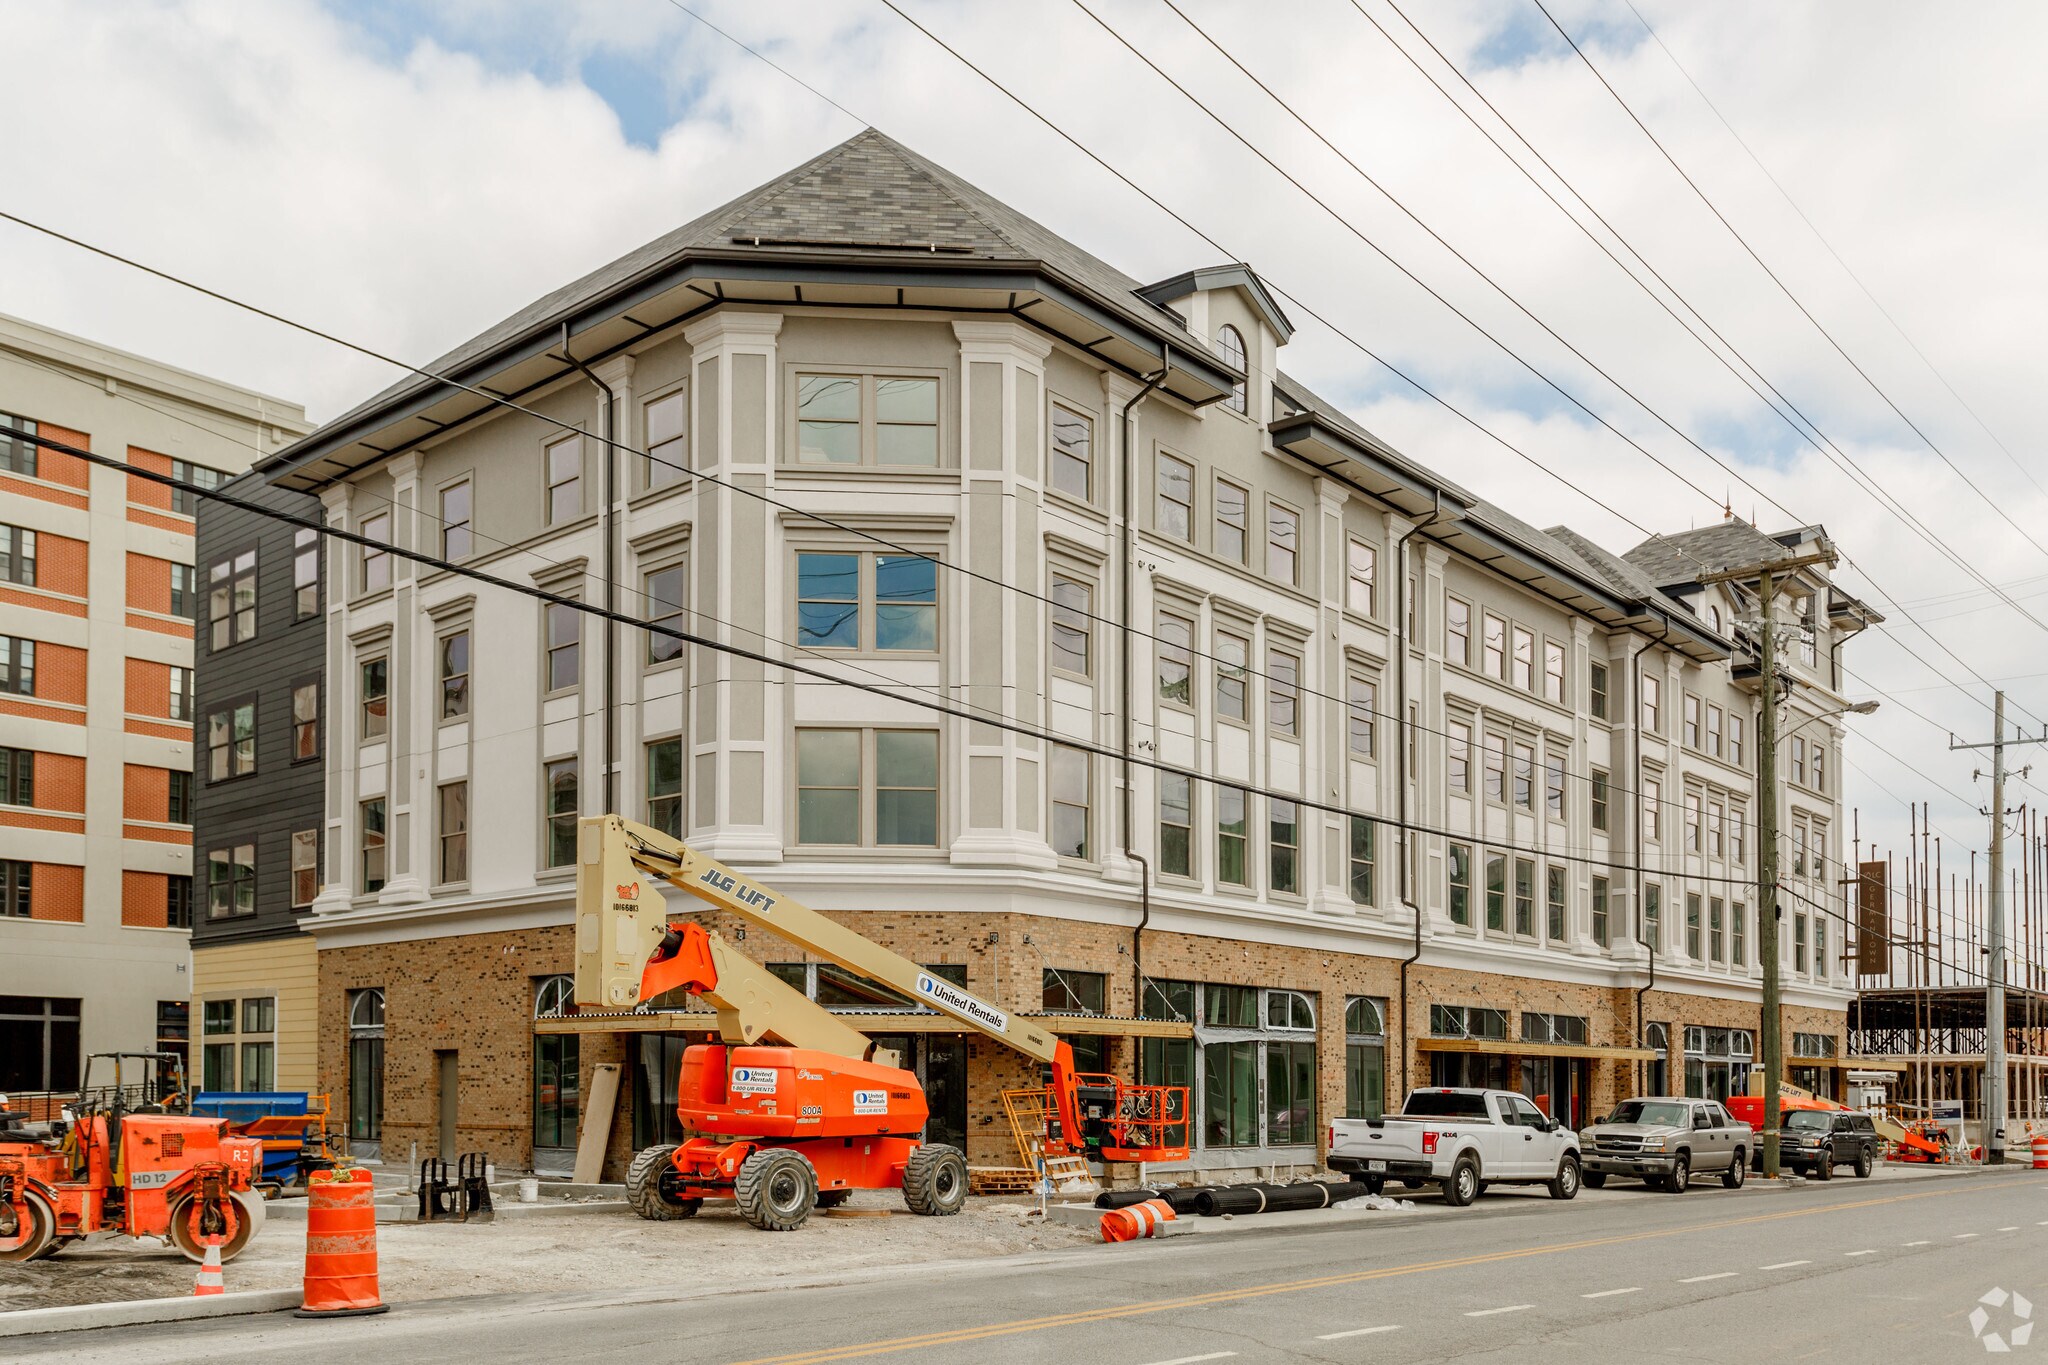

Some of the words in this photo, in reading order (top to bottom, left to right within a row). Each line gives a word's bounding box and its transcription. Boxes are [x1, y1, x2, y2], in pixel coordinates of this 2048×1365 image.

[700, 868, 736, 893] JLG
[735, 884, 776, 913] LIFT
[1868, 885, 1877, 964] GERMANTOWN
[934, 985, 968, 1010] United
[967, 1001, 1003, 1028] Rentals
[802, 1106, 822, 1115] 800A
[132, 1174, 151, 1184] HD
[155, 1173, 167, 1183] 12
